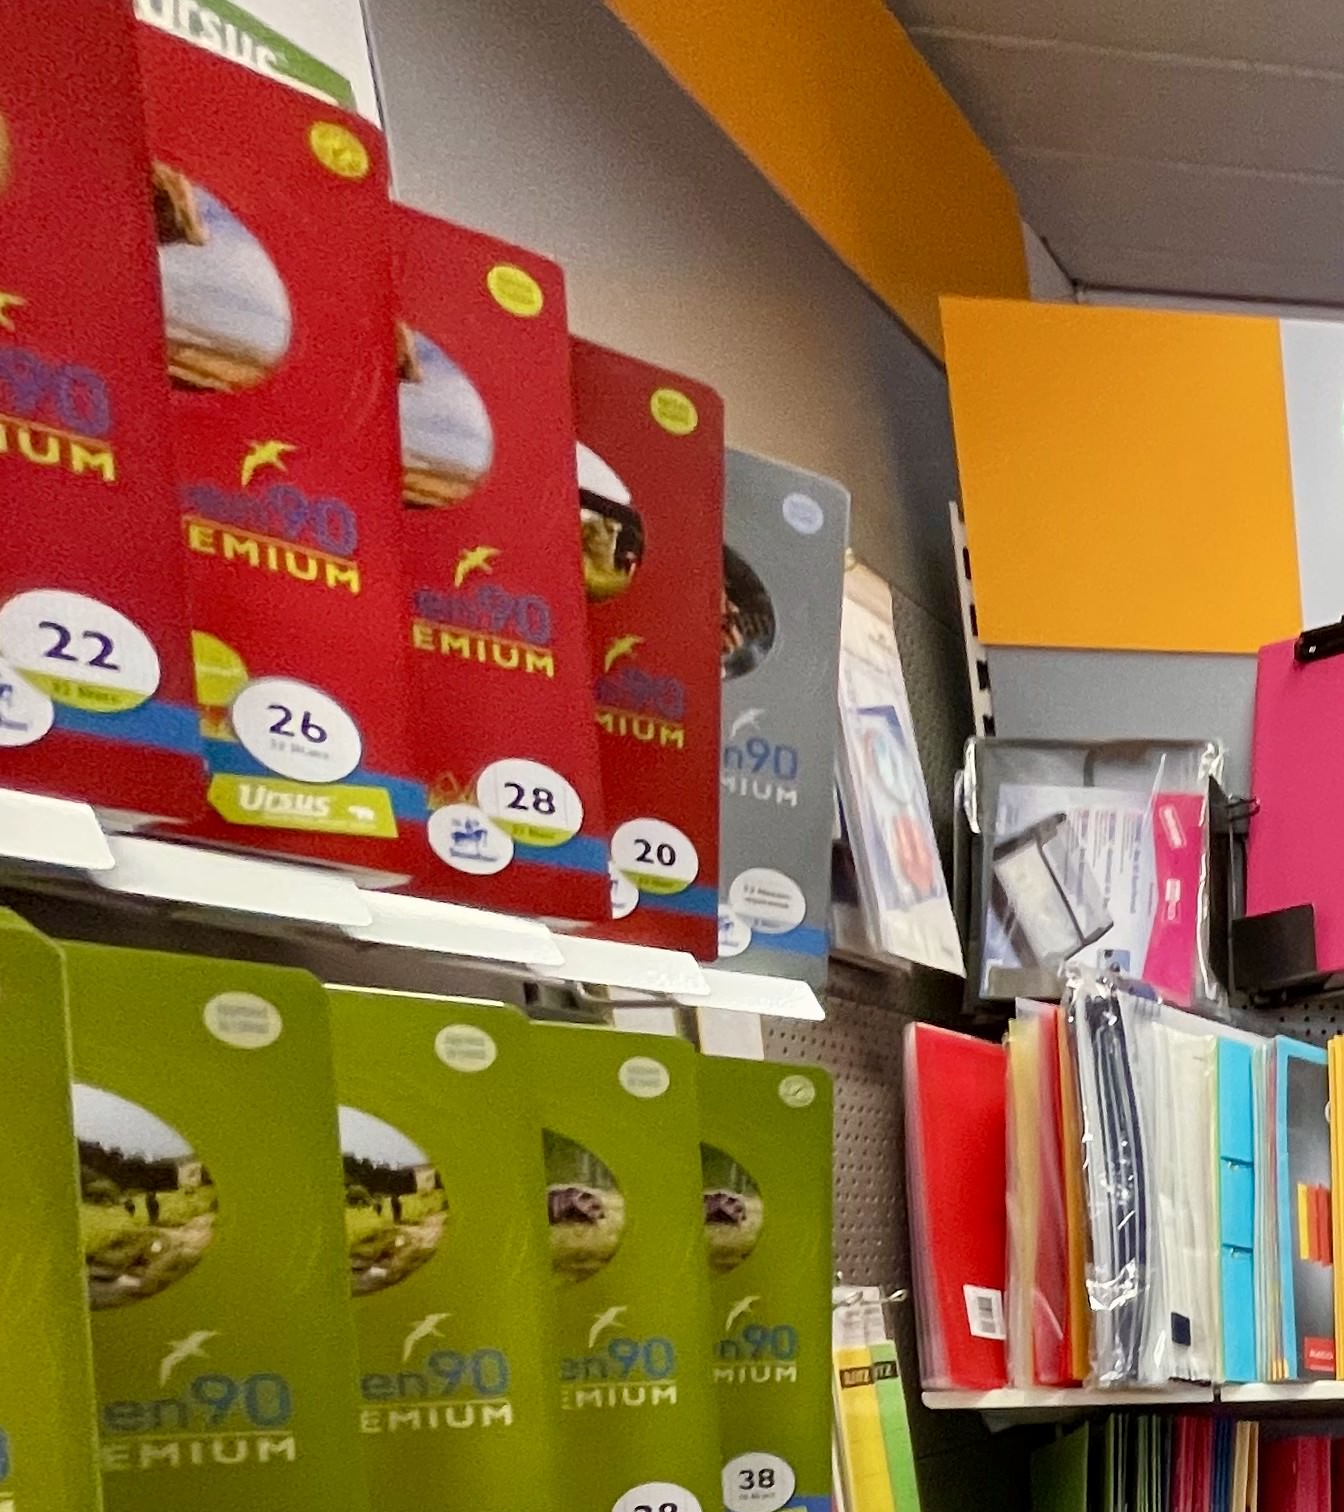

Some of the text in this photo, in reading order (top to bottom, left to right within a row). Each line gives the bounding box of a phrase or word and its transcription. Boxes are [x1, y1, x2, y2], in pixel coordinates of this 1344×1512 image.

[38, 620, 121, 672] 22
[268, 703, 328, 744] 26
[503, 781, 557, 817] 28
[633, 838, 677, 868] 20
[359, 1401, 514, 1435] EMIUM
[739, 1467, 776, 1491] 38
